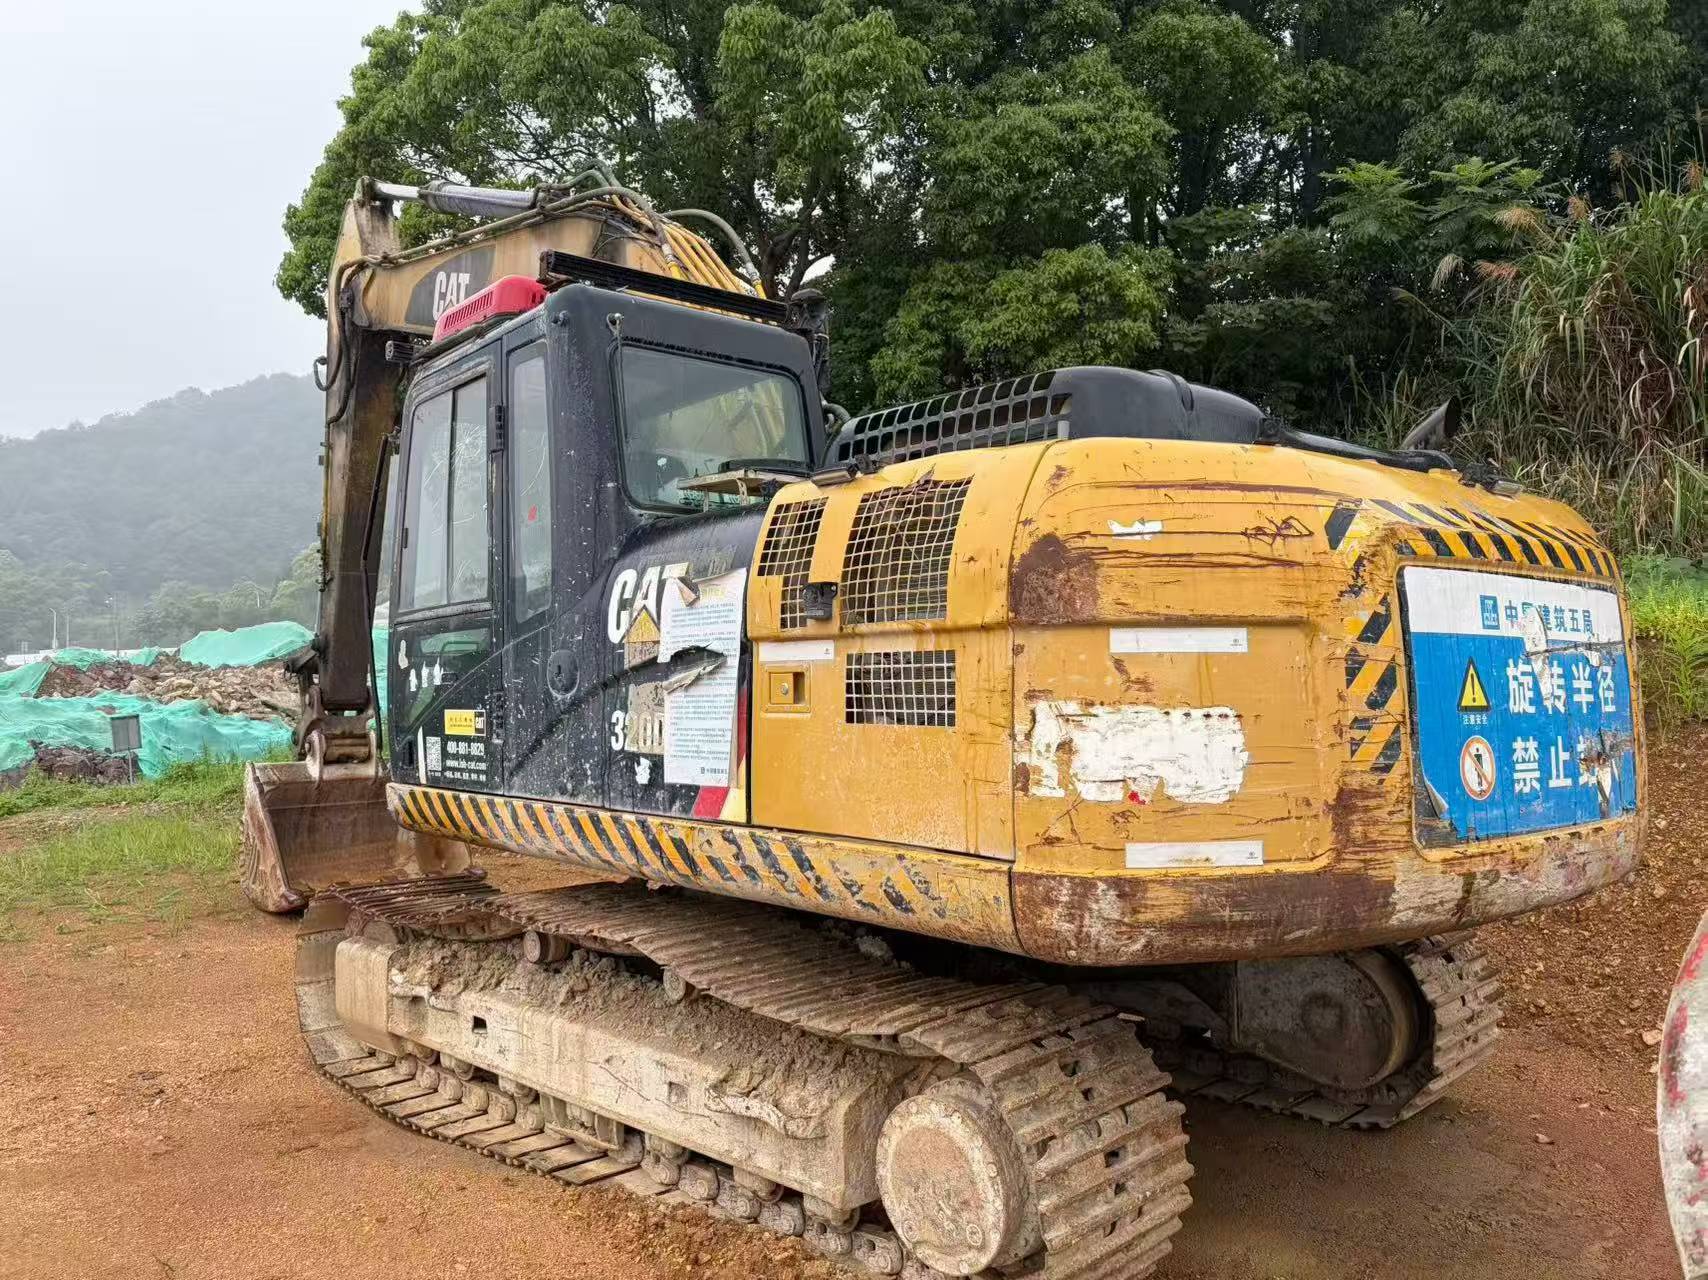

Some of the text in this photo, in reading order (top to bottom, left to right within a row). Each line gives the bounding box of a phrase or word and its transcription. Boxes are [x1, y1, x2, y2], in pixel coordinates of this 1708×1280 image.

[432, 271, 471, 321] CAT
[1506, 658, 1616, 714] 旋转半径
